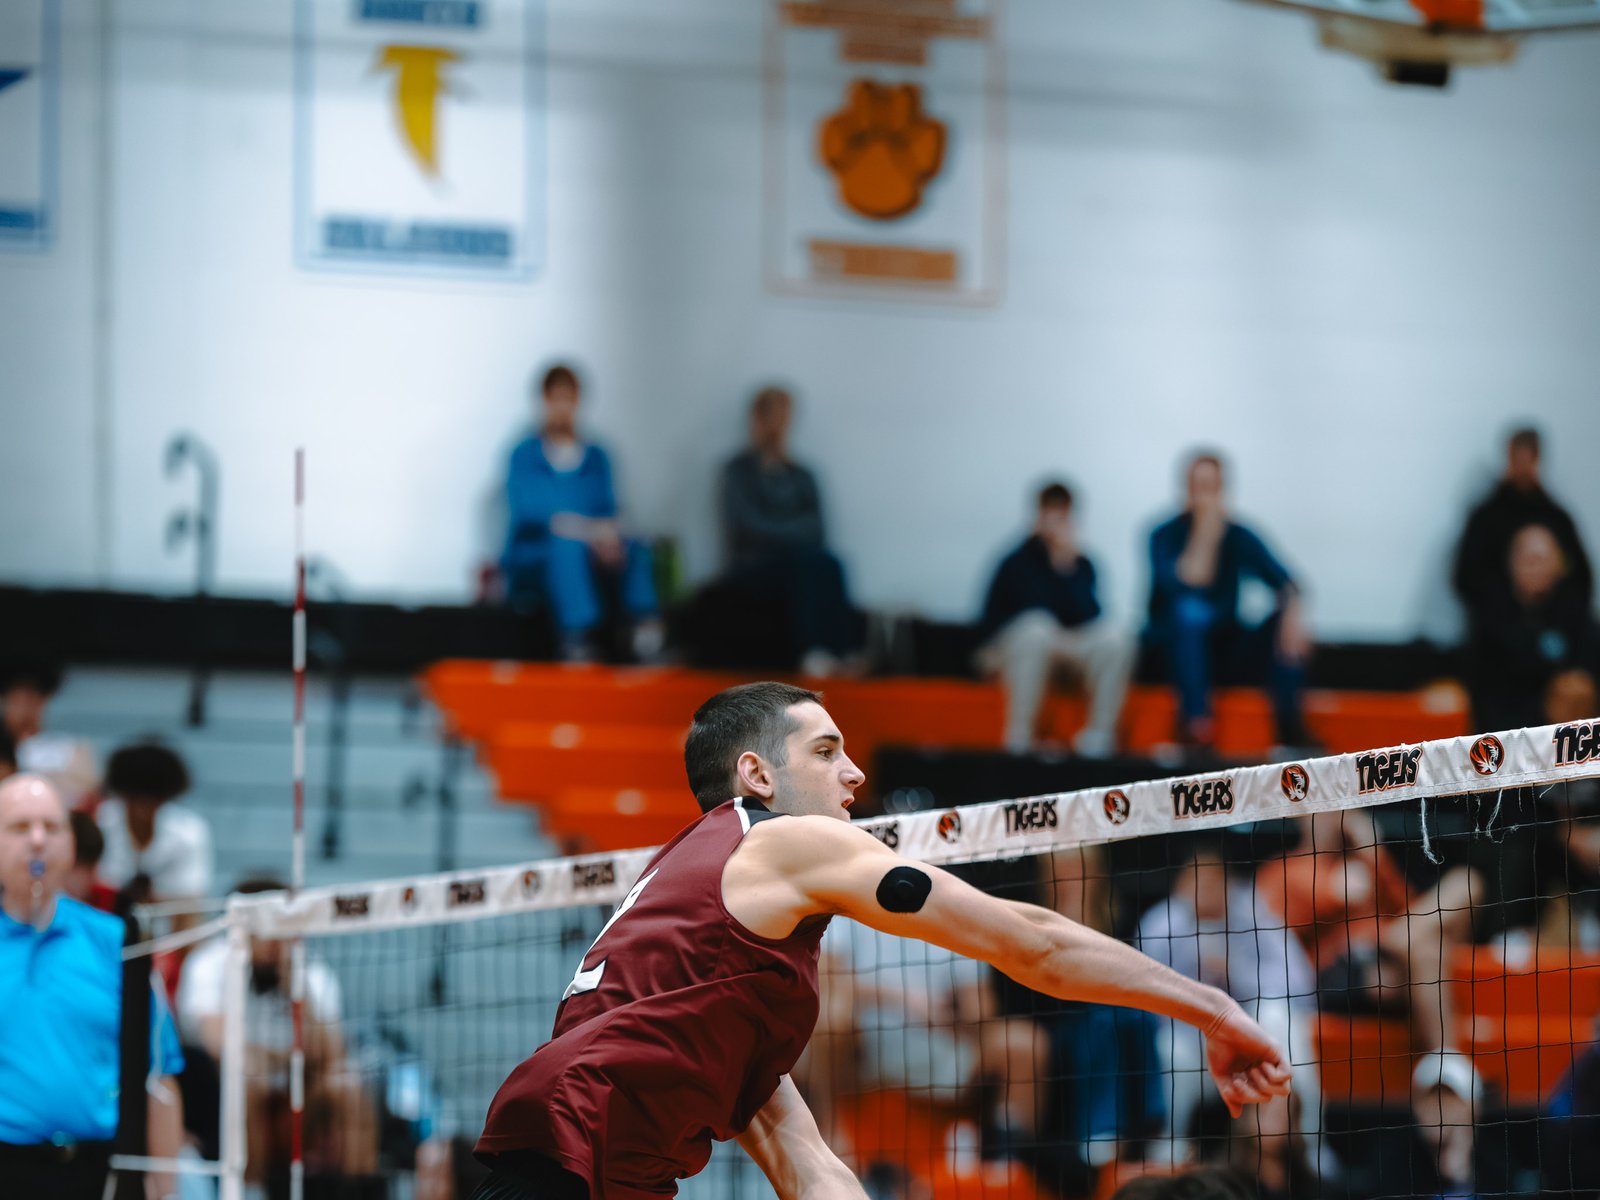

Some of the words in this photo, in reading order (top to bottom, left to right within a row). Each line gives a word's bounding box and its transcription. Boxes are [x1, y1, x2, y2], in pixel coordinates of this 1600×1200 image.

[1003, 798, 1058, 837] TIGERS
[1170, 776, 1235, 820] TIGERS
[1356, 746, 1424, 794] TIGERS
